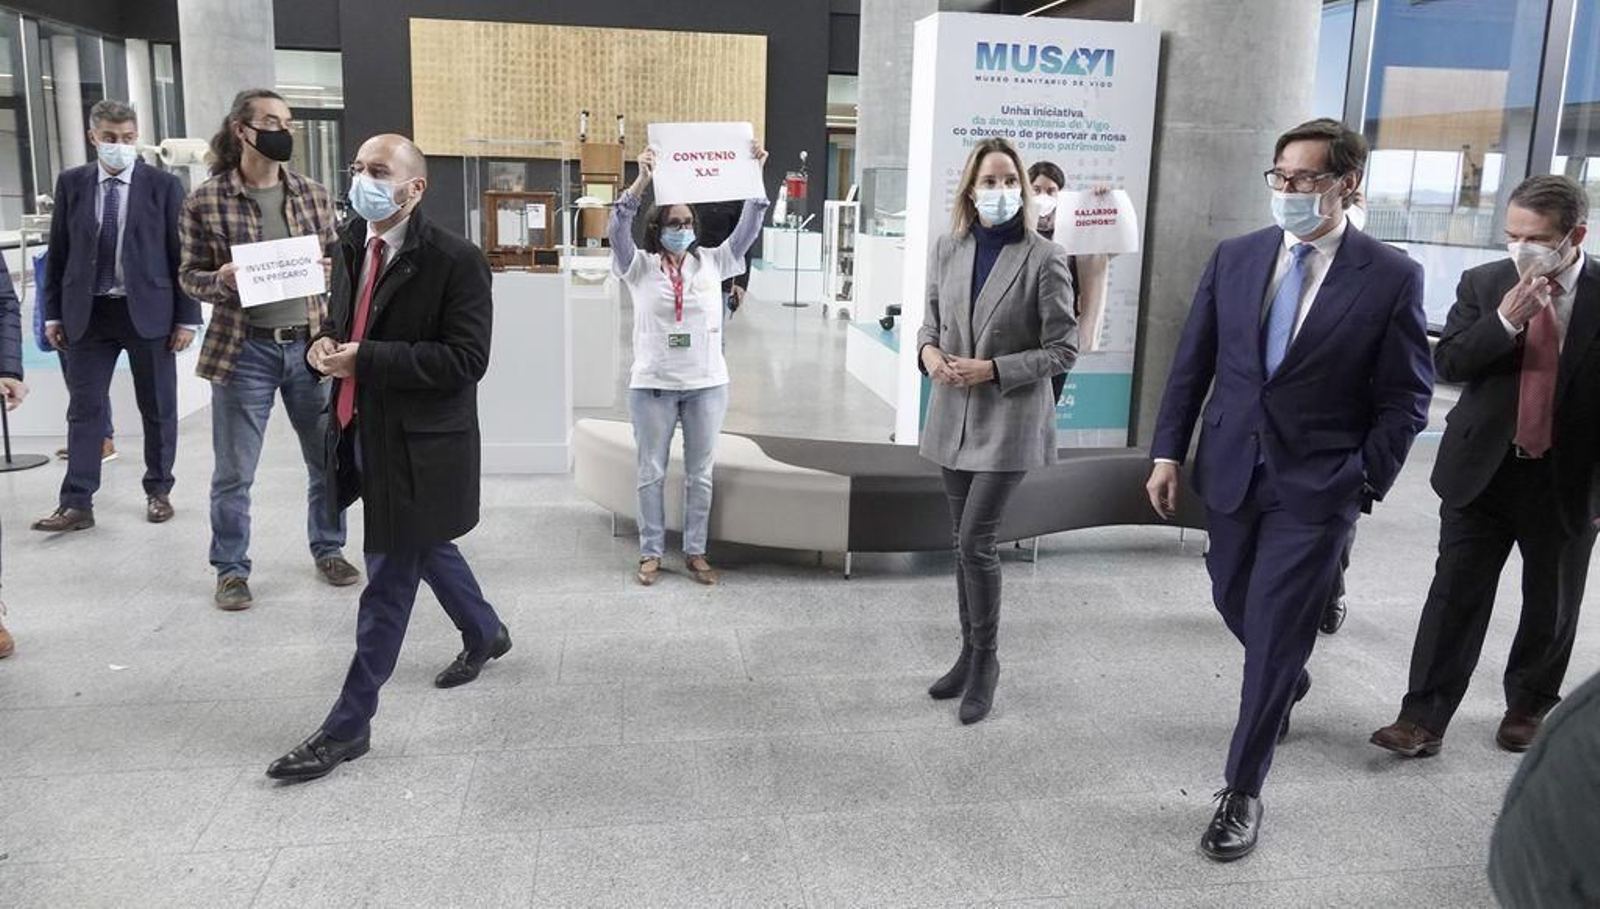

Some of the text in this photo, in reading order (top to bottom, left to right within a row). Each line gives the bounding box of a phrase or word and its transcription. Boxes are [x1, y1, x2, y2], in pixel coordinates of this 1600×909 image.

[976, 41, 1115, 77] MUSAVI
[1014, 77, 1068, 86] SANITARIO
[1001, 105, 1084, 118] Unha iniciativa
[972, 115, 987, 126] da
[1018, 117, 1066, 128] sanitaria
[1068, 118, 1082, 129] de
[1086, 119, 1110, 131] Vigo
[952, 127, 1127, 143] co obxecto de preservar a nosa
[1028, 141, 1055, 151] noso
[1057, 141, 1117, 153] patrimonio
[673, 151, 736, 162] CONVENIO
[1074, 208, 1118, 216] SALARIOS
[245, 257, 312, 273] INVESTIGACIÓN
[253, 275, 265, 284] EN
